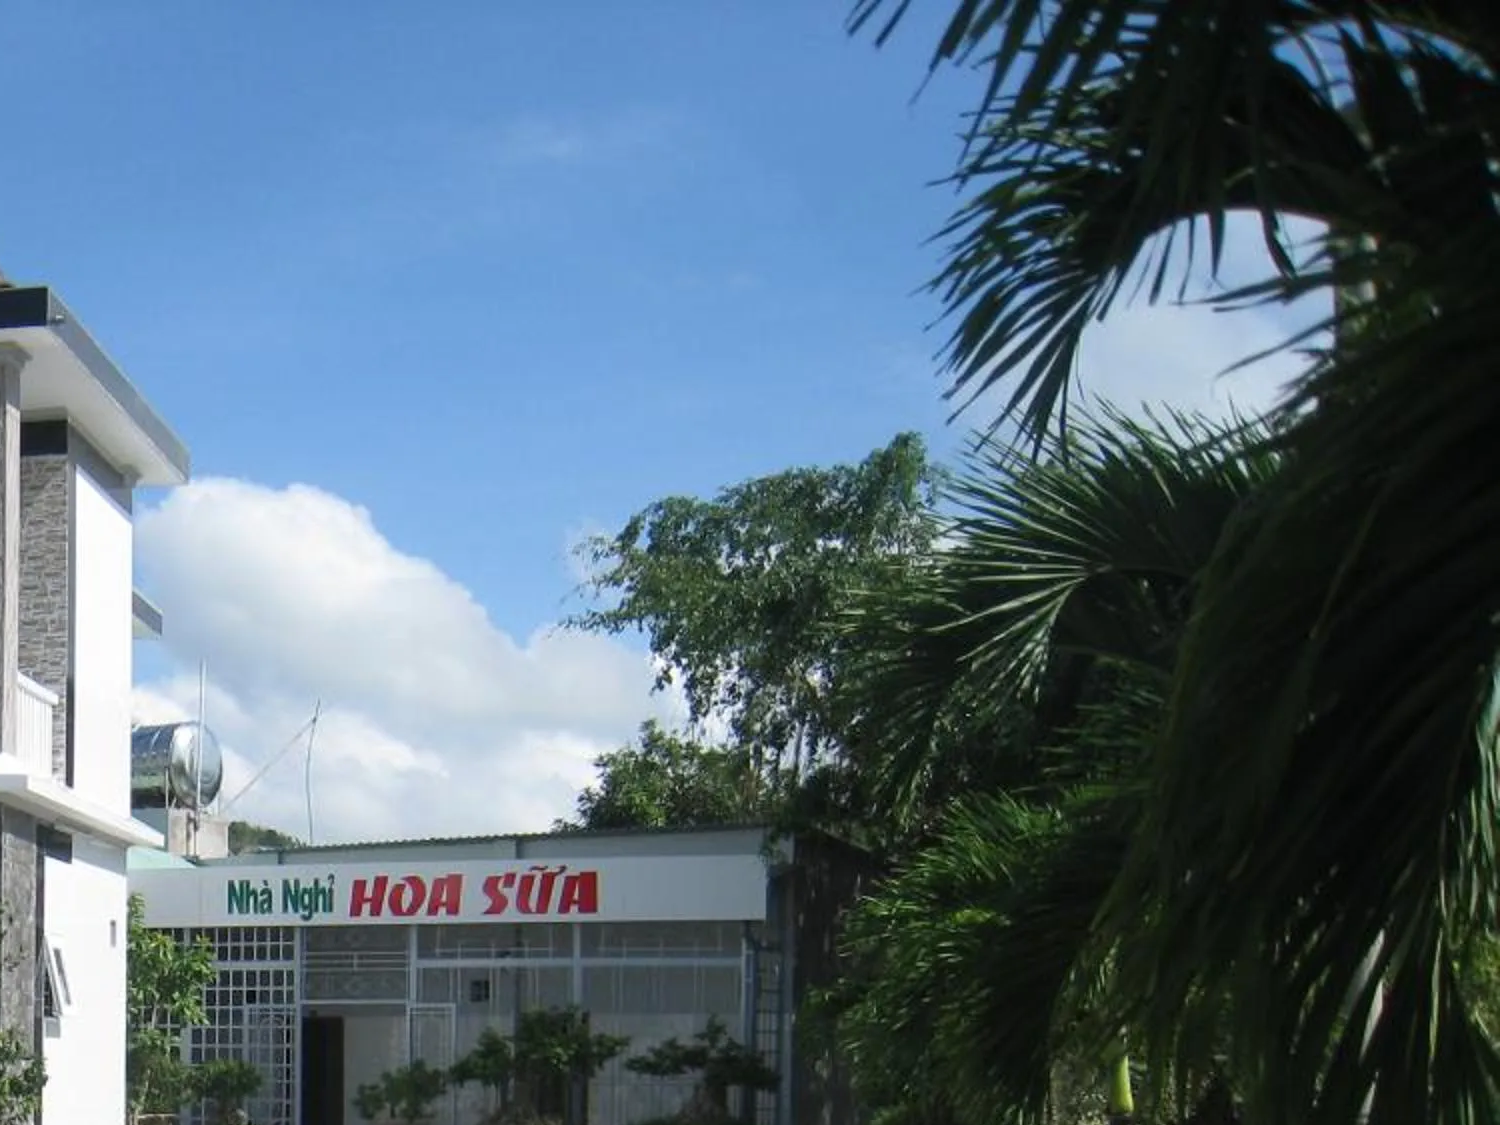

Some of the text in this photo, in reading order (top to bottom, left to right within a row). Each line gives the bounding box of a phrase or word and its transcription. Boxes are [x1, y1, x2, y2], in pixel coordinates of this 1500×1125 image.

[227, 865, 599, 921] Nhà Nghỉ HOA SỮA
